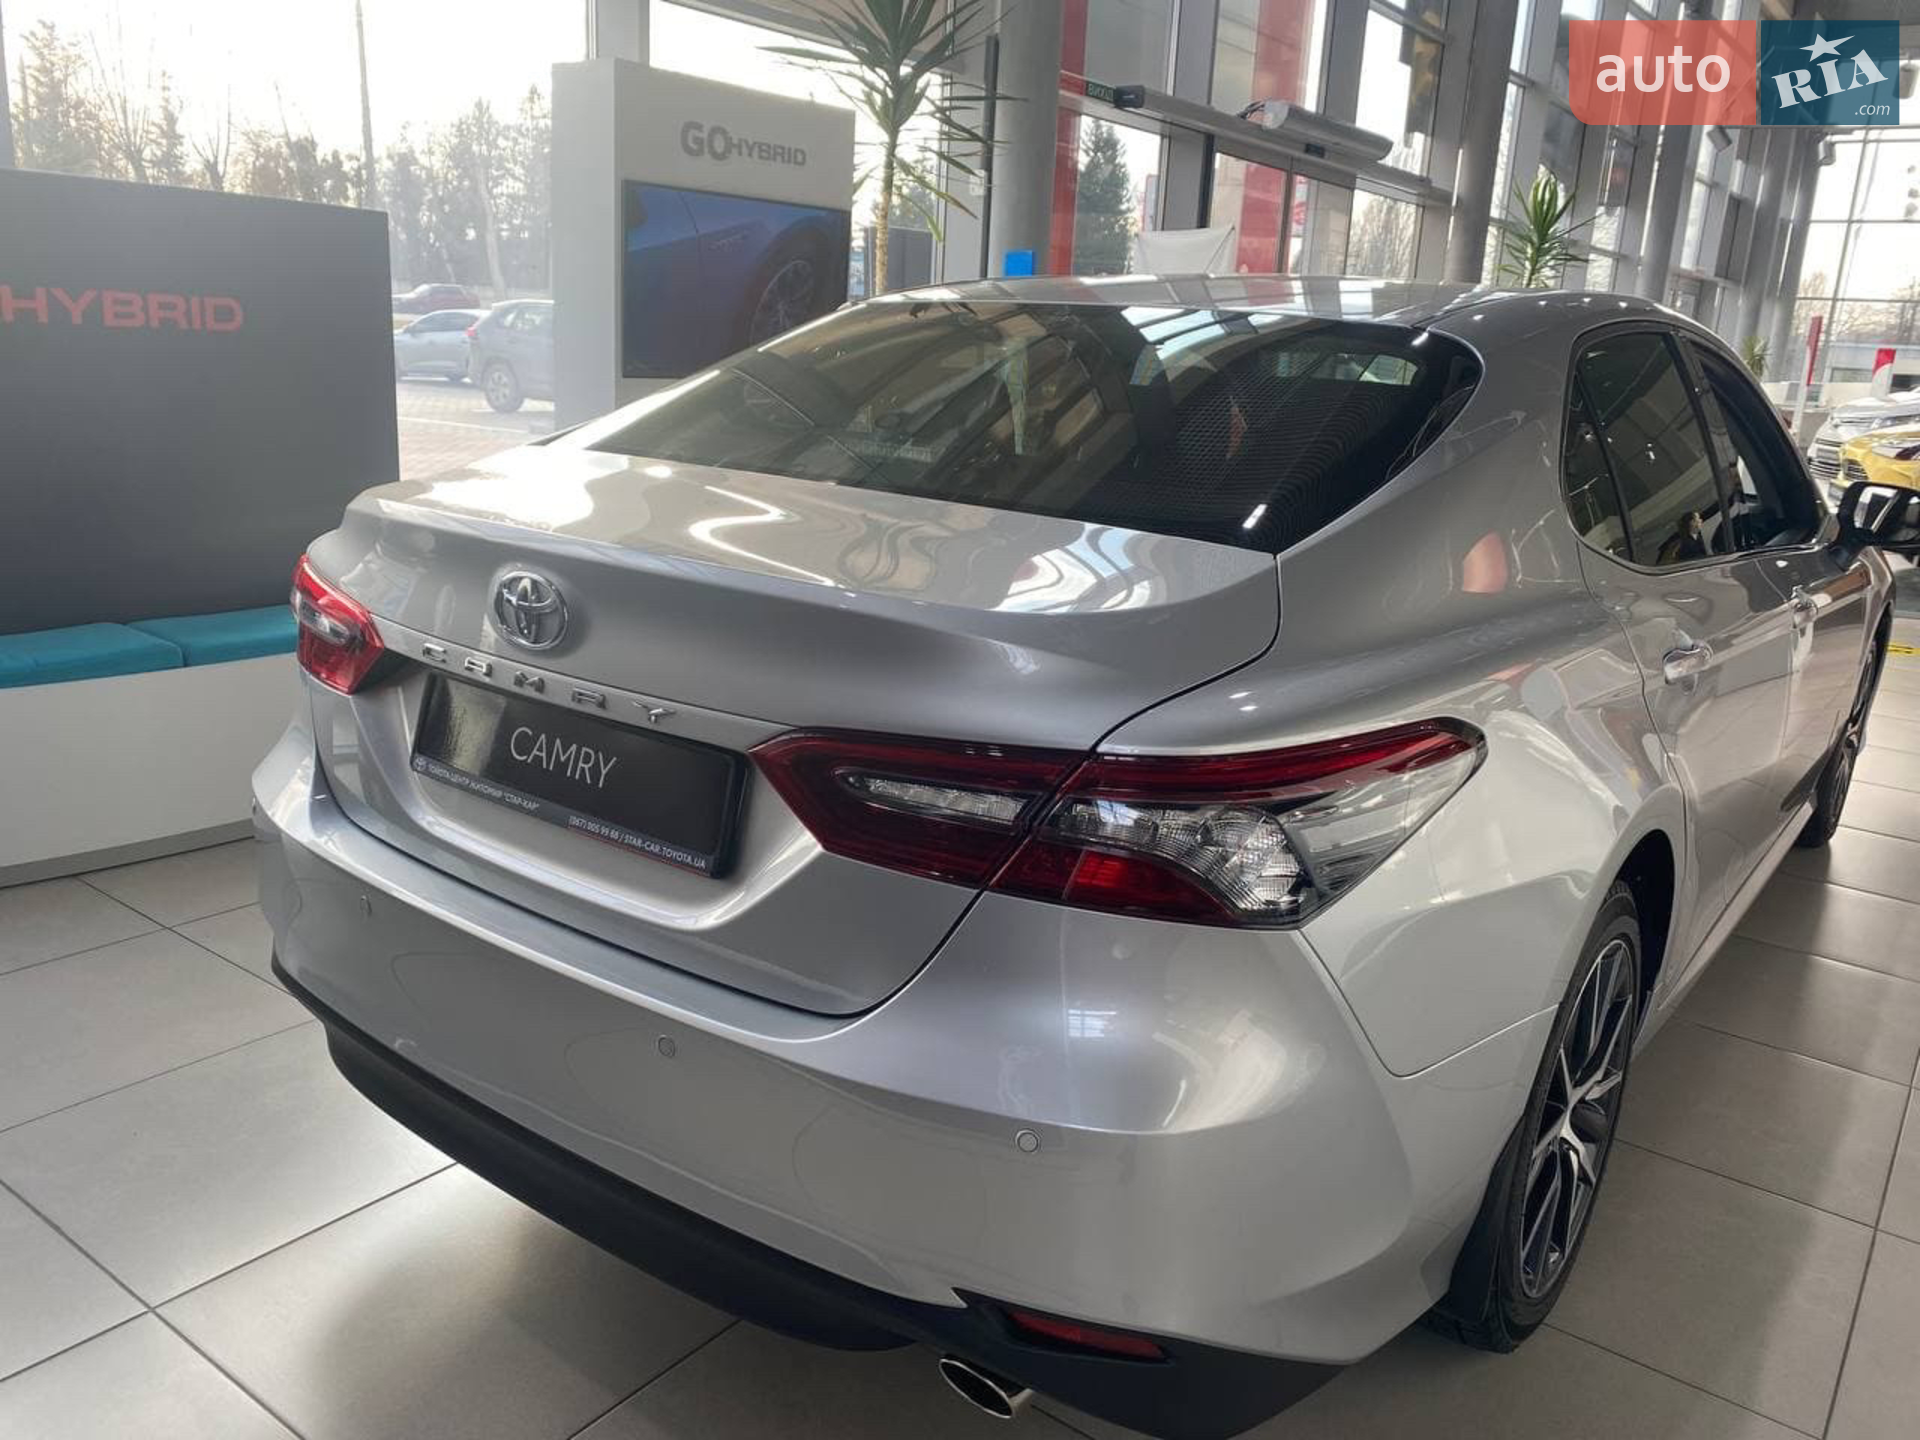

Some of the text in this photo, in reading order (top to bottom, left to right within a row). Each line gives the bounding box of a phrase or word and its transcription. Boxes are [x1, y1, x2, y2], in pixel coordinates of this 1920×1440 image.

[0, 284, 243, 332] HYBRID
[422, 642, 677, 725] CAMRY
[510, 726, 617, 788] CAMRY
